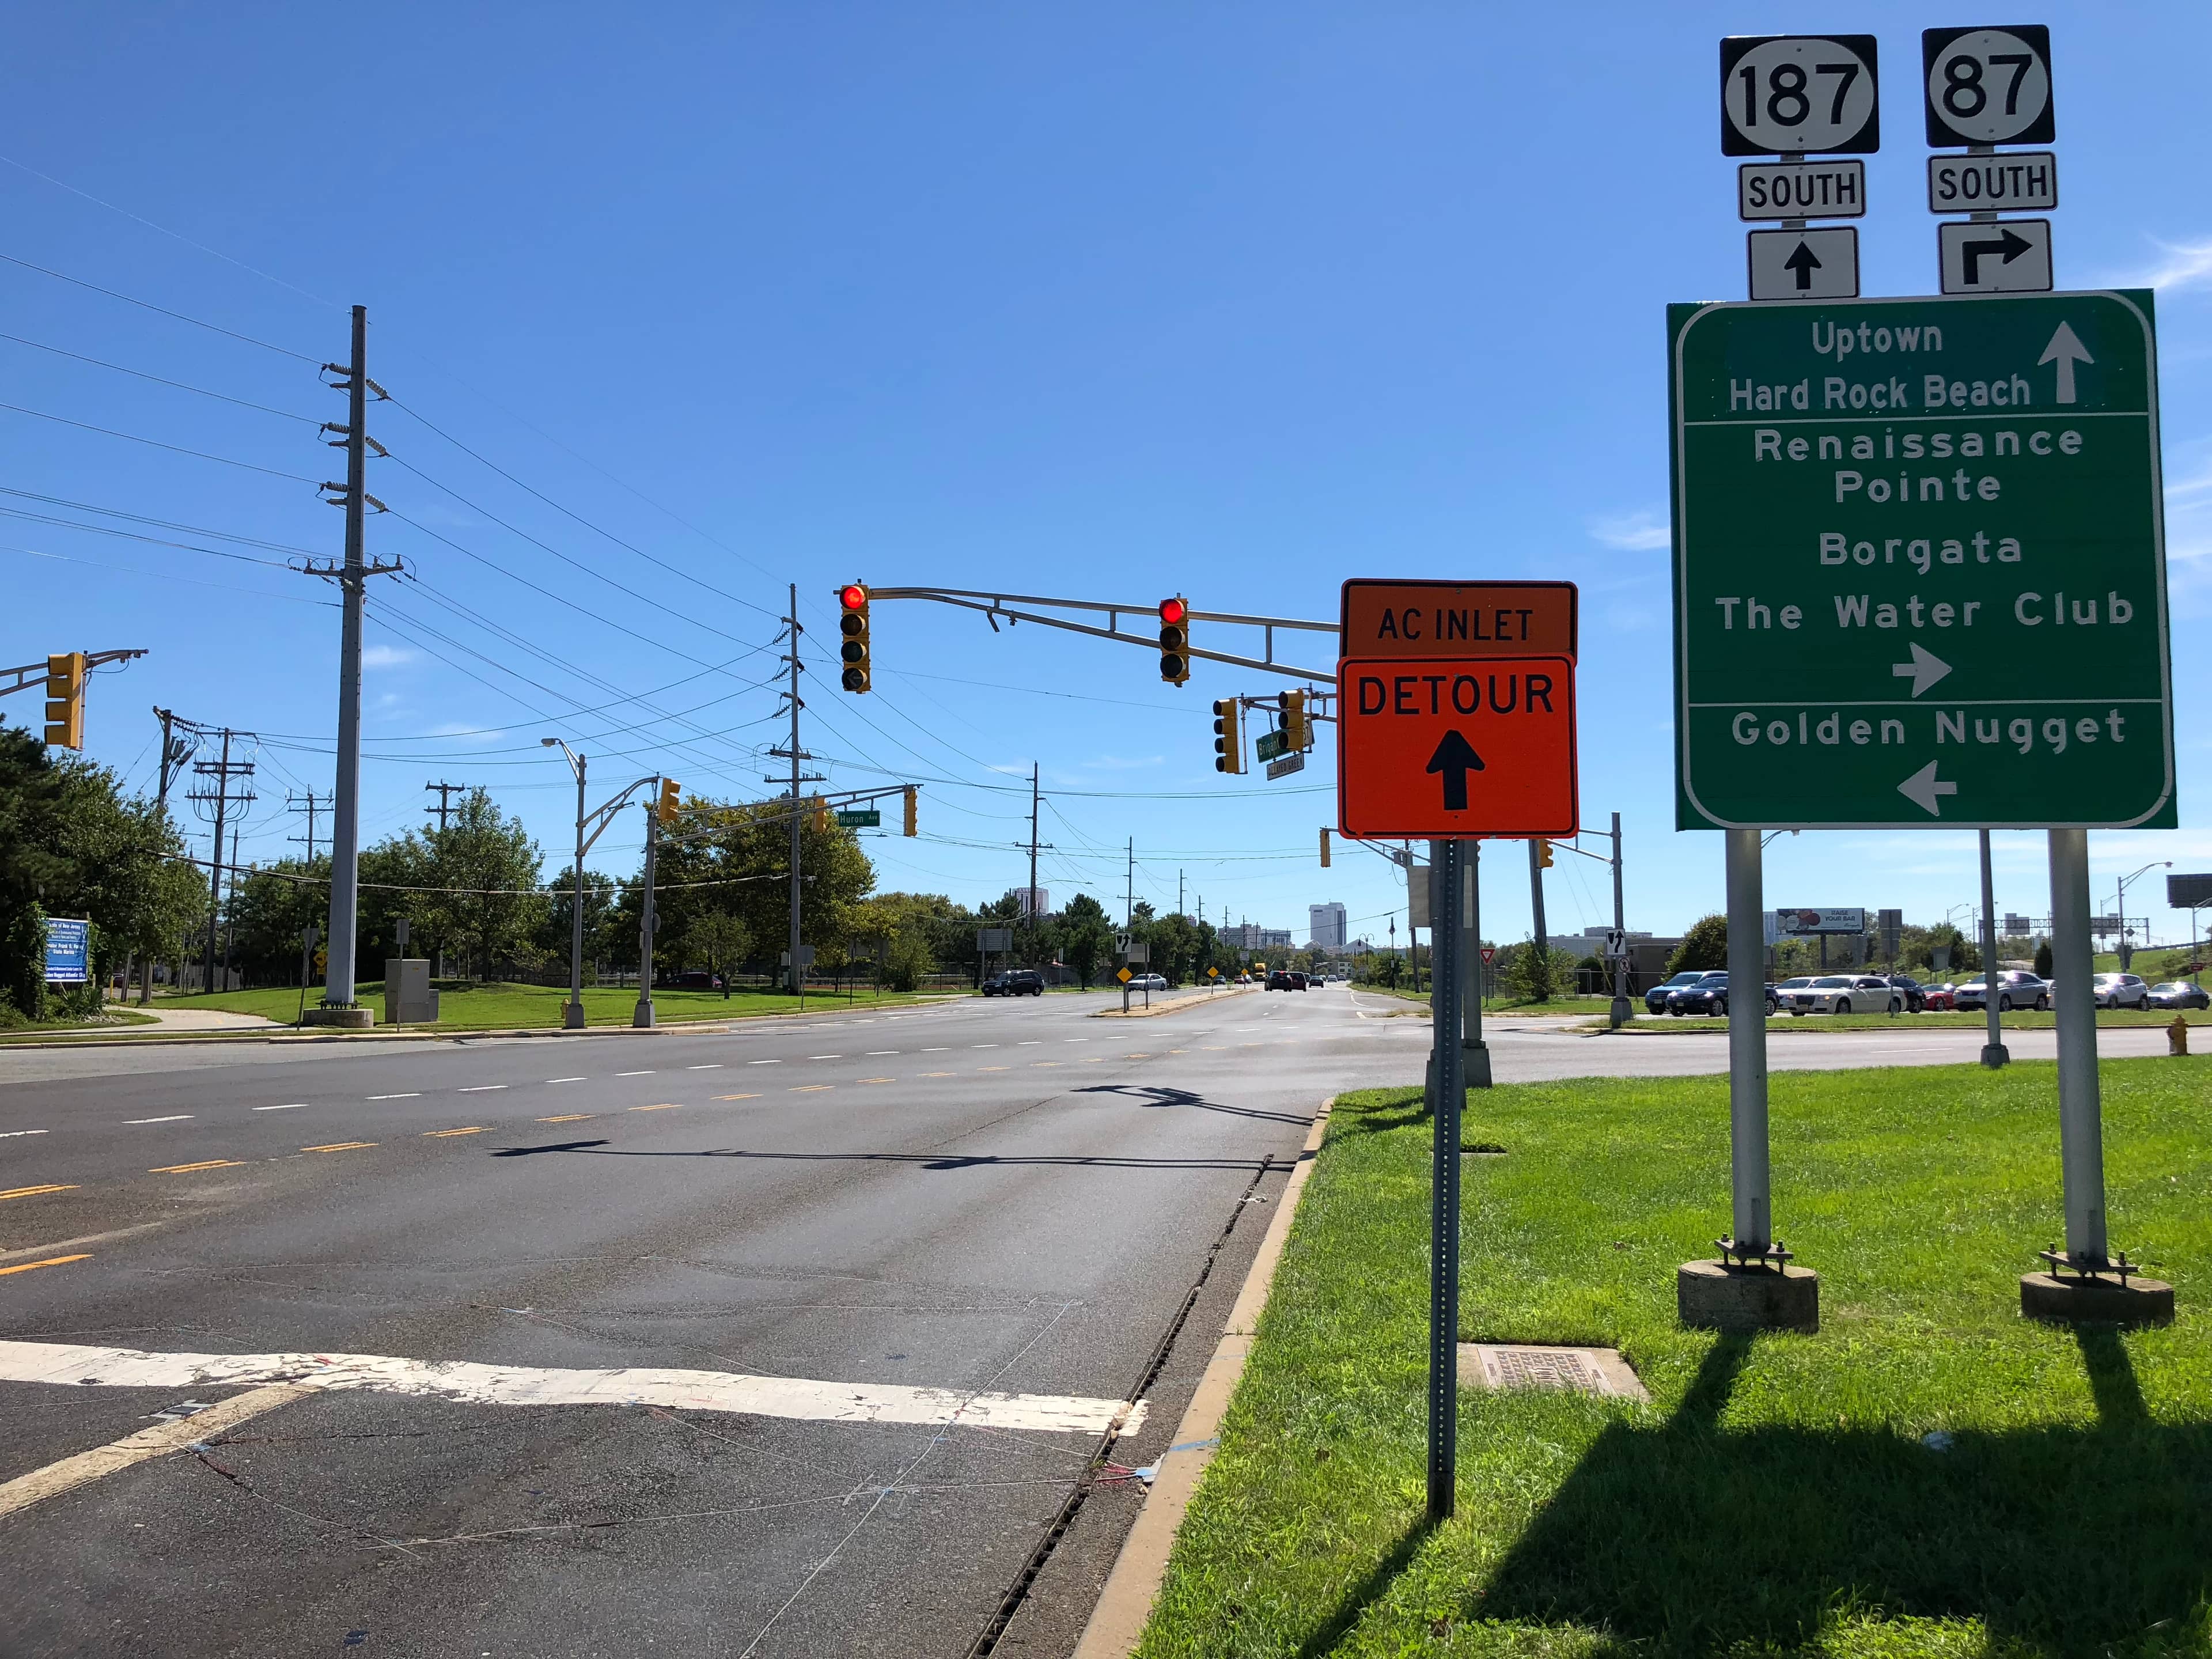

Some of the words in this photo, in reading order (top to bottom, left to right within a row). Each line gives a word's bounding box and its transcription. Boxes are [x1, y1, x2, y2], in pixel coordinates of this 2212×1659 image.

[1739, 63, 1859, 126] 187
[1943, 54, 2032, 118] 87
[1749, 173, 1855, 208] SOUTH
[1938, 165, 2047, 200] SOUTH
[1812, 321, 1942, 362] Uptown
[1730, 378, 1809, 411] Hard
[1824, 376, 1907, 410] Rock
[1923, 373, 2031, 408] Beach
[1754, 427, 2083, 462] Renaissance
[1835, 468, 2001, 503] Pointe
[1819, 531, 2022, 575] Borgata
[1377, 608, 1421, 640] AC
[1435, 609, 1533, 641] INLET
[1715, 597, 1802, 630] The
[1834, 594, 1981, 628] Water
[2014, 591, 2133, 626] Club
[1359, 673, 1554, 715] DETOUR
[1259, 737, 1280, 756] Brigant
[1732, 711, 1905, 745] Golden
[1936, 709, 2125, 755] Nugget
[1288, 755, 1302, 771] GREEN
[840, 815, 863, 823] Huron
